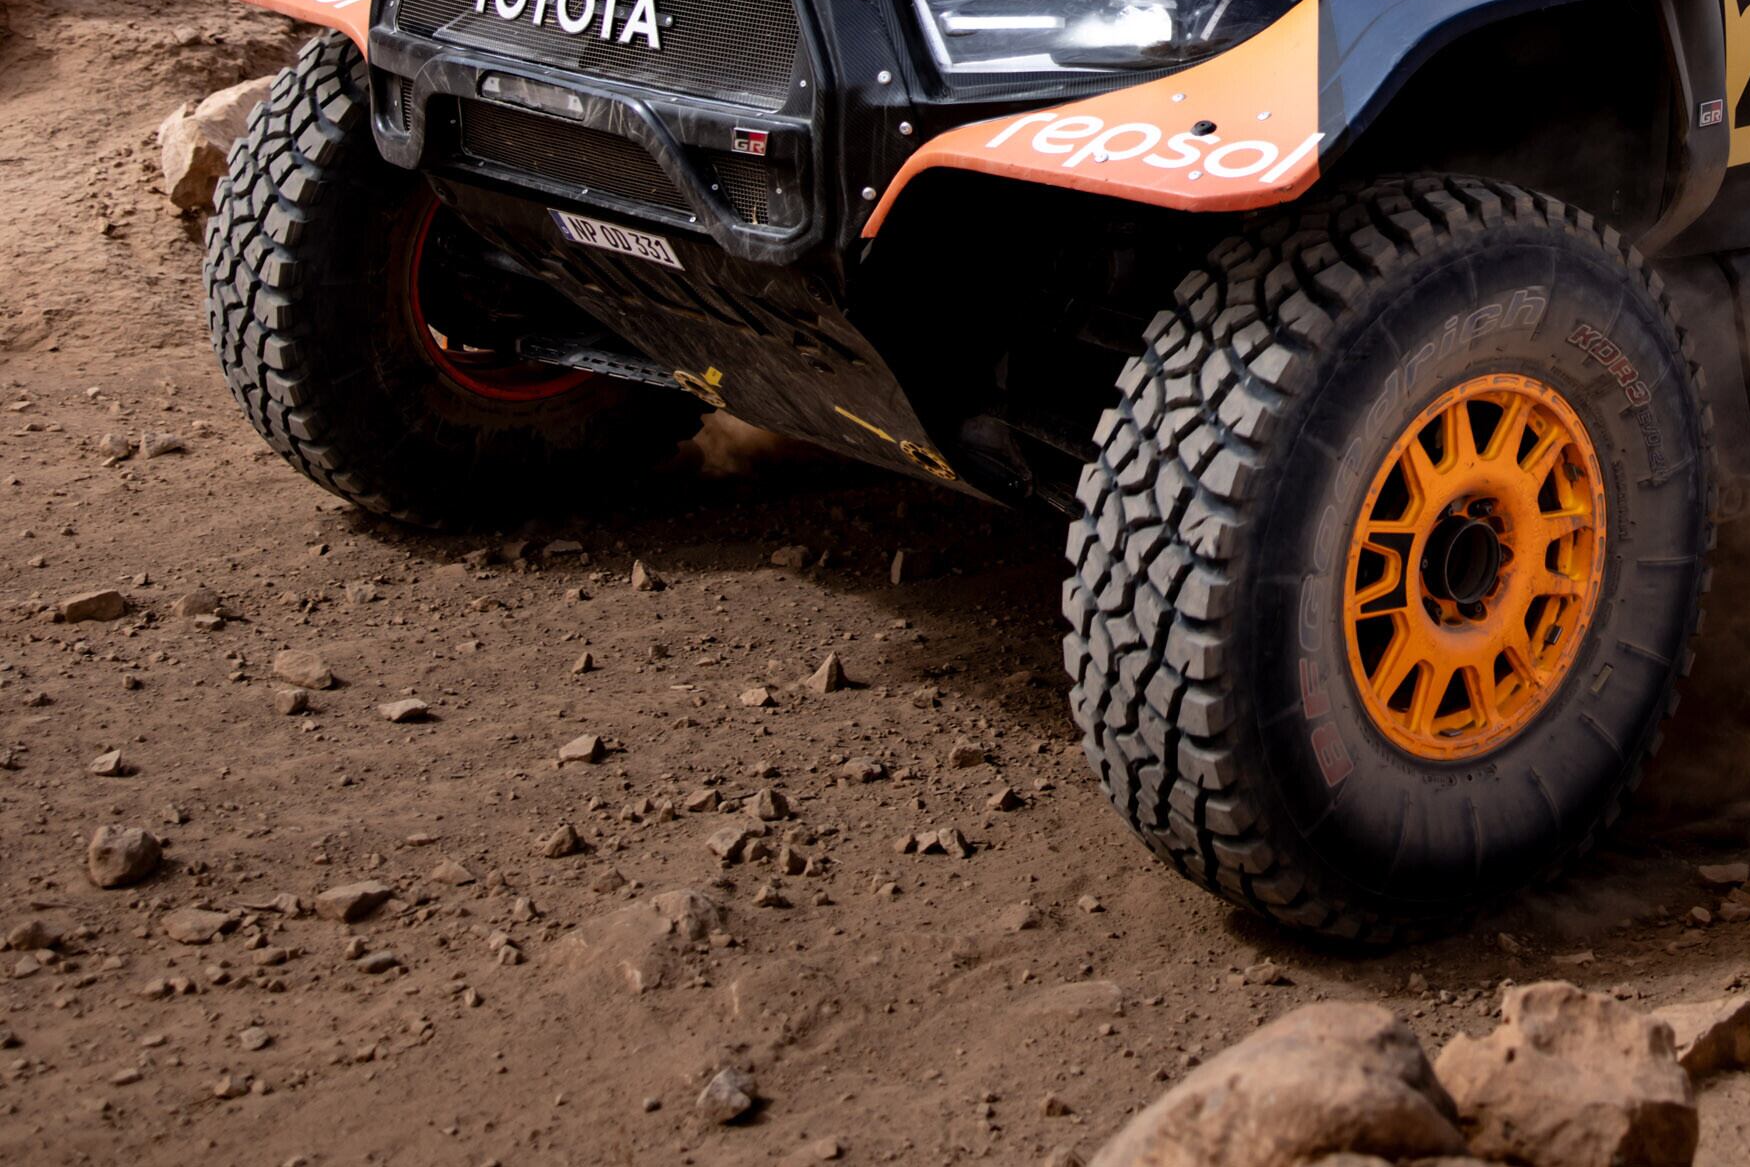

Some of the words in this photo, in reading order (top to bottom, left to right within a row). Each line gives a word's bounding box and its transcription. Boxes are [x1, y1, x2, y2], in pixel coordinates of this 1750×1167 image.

[1701, 110, 1723, 125] GR
[733, 137, 766, 155] GR
[985, 112, 1325, 183] repsol
[567, 217, 597, 243] NP
[629, 233, 675, 264] 331
